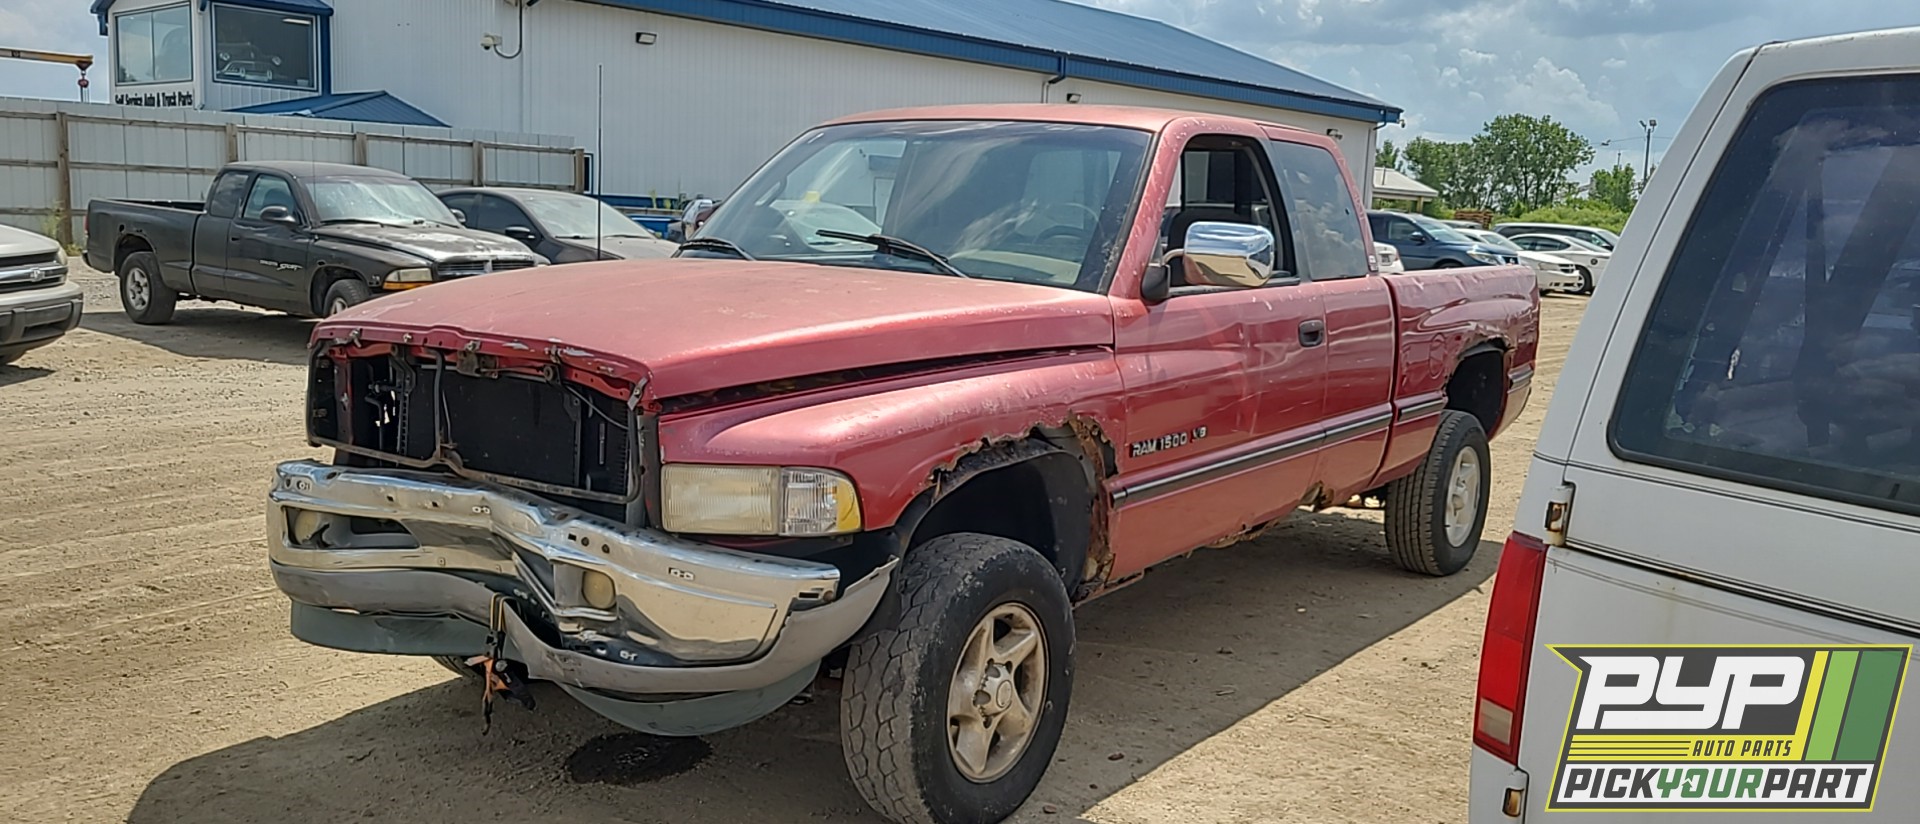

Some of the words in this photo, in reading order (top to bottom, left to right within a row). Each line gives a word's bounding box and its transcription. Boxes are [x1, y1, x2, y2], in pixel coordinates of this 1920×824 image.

[178, 91, 193, 106] Parts
[1132, 441, 1157, 457] RAM
[1160, 433, 1187, 450] 1500
